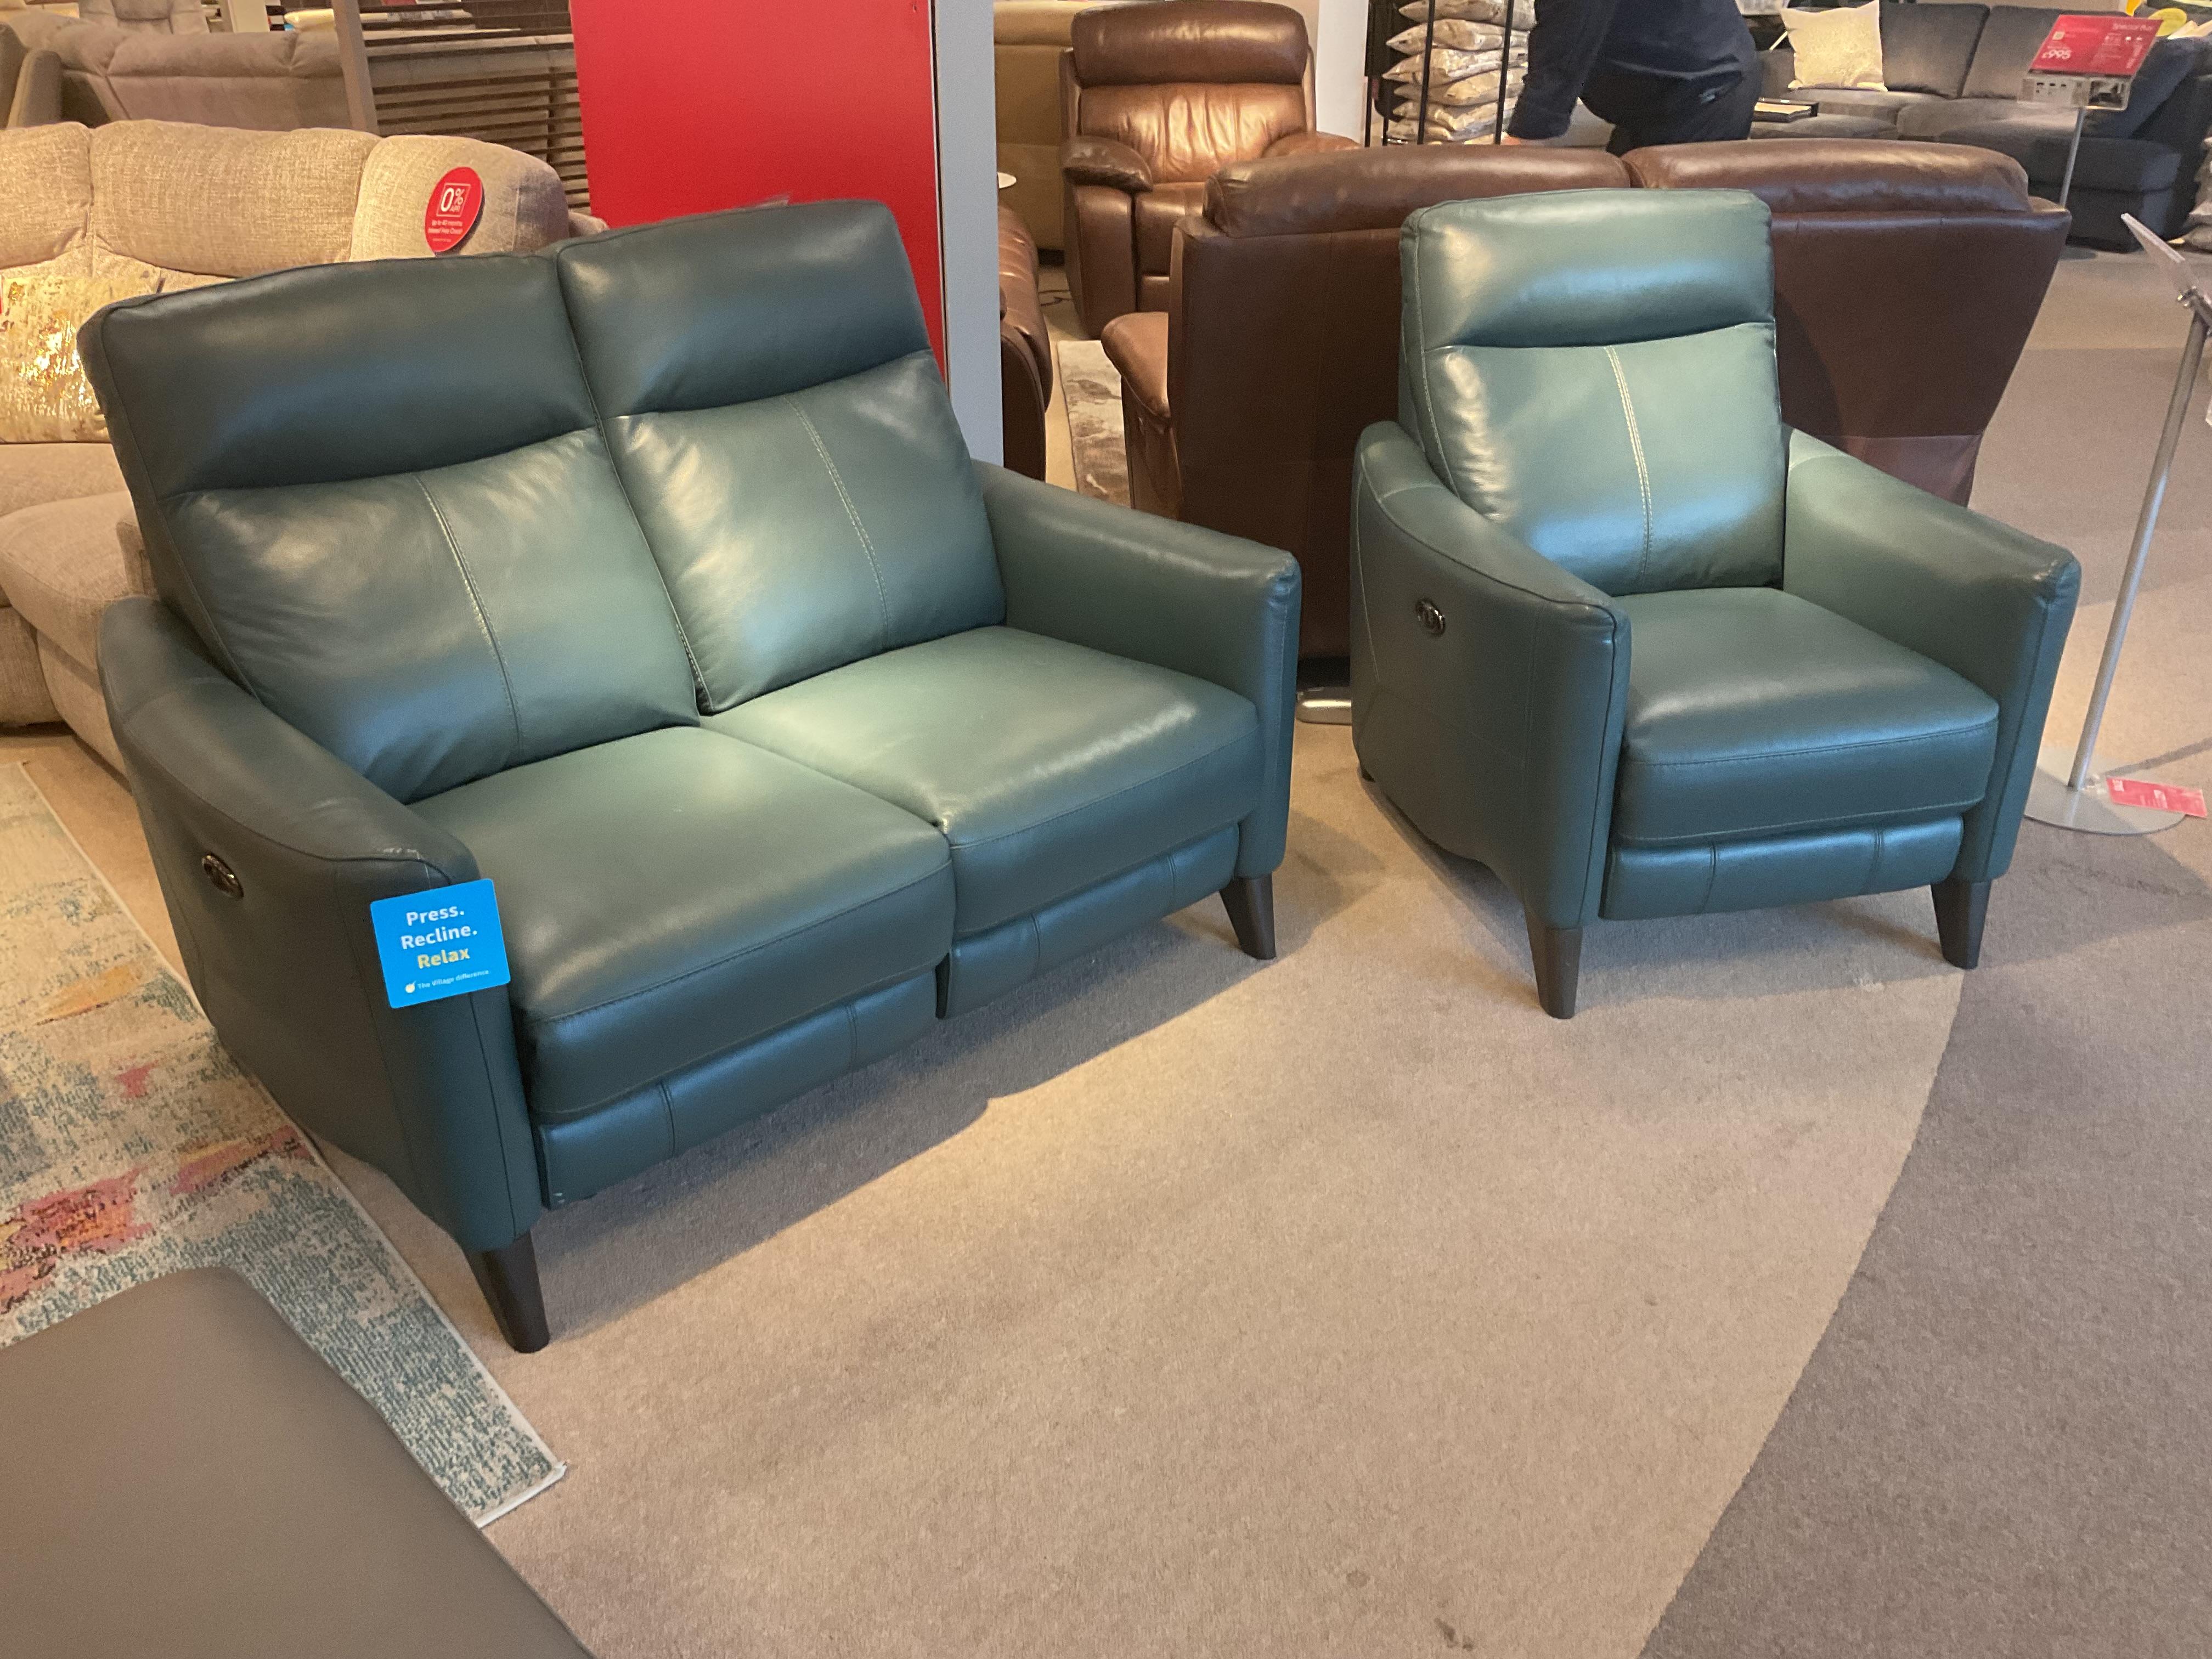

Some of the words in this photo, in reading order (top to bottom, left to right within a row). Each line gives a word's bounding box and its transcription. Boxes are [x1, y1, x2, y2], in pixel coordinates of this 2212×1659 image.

[441, 187, 465, 212] 0%
[406, 906, 465, 927] Press.
[400, 925, 477, 950] Recline.
[417, 948, 470, 969] Relax
[432, 977, 454, 986] Village
[456, 969, 489, 981] difference
